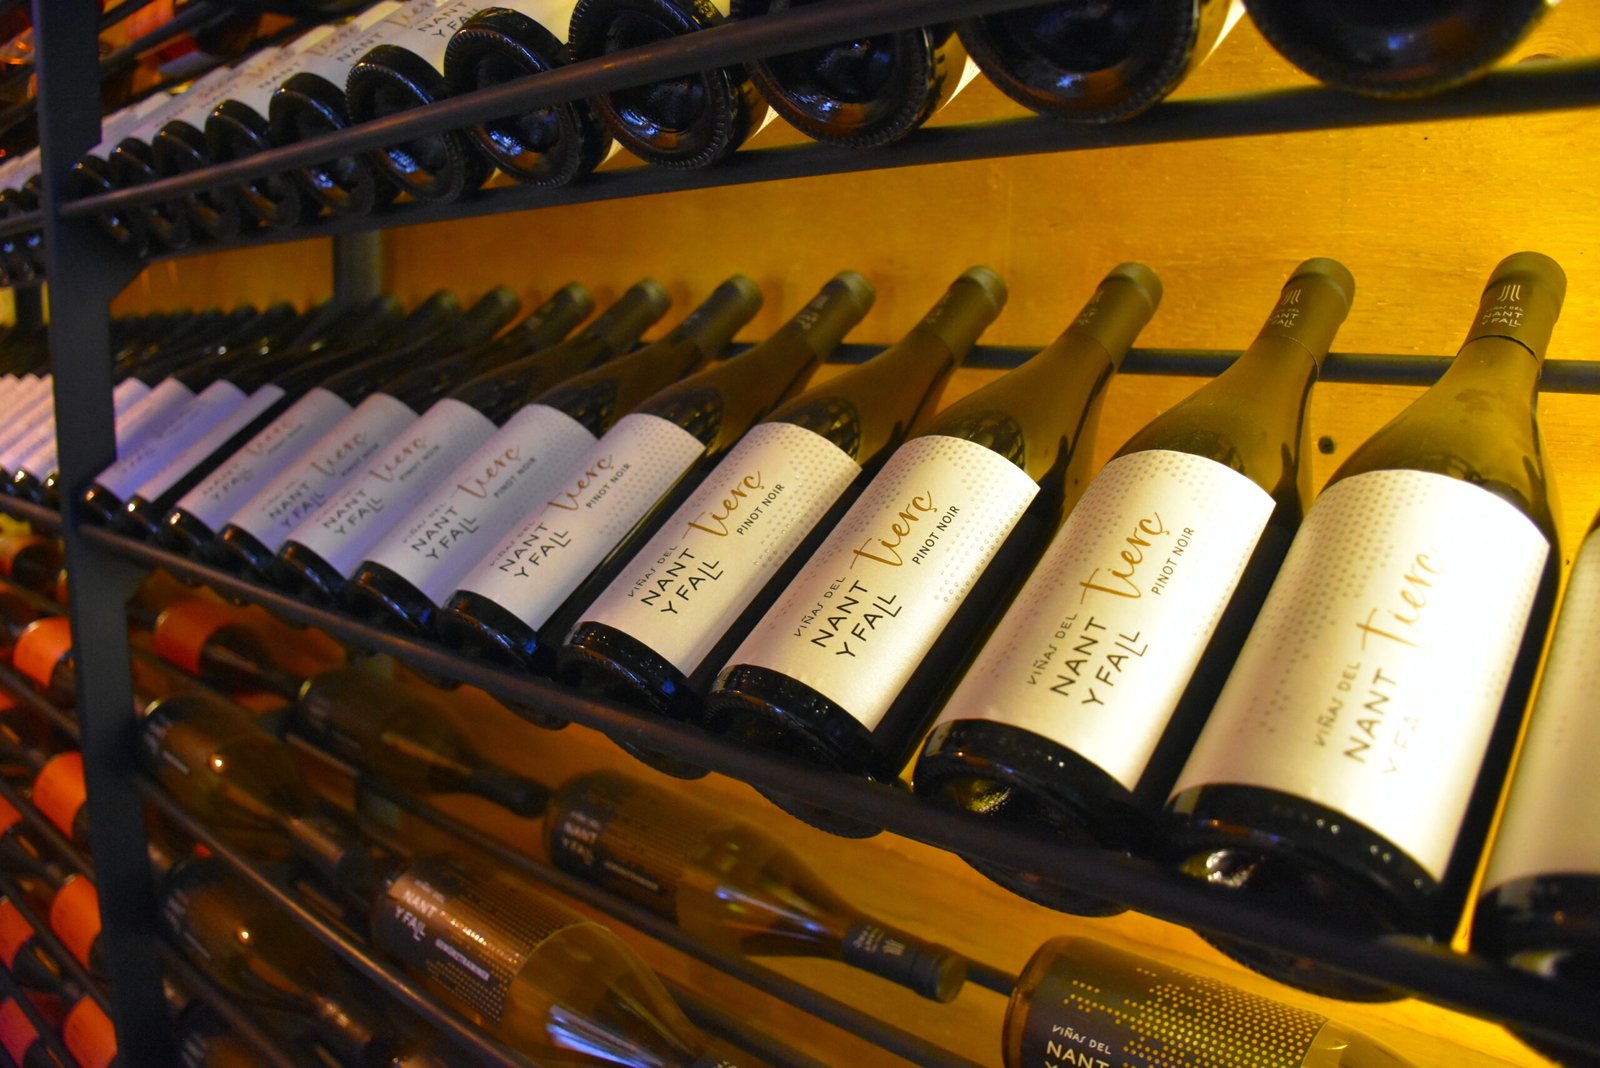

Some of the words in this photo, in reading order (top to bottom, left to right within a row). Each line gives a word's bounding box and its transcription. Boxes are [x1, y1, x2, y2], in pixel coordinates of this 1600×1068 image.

[585, 482, 611, 509] PINOT
[609, 462, 632, 485] NOIR
[736, 503, 764, 537] PINOT
[762, 483, 786, 508] NOIR
[411, 505, 459, 553] NANT
[425, 547, 440, 561] Y
[439, 514, 481, 551] FALL
[499, 522, 549, 573] NANT
[513, 565, 530, 580] Y
[528, 528, 573, 567] FALL
[911, 530, 940, 566] PINOT
[938, 504, 961, 533] NOIR
[627, 567, 657, 598] VIÑAS
[656, 544, 679, 566] DEL
[640, 547, 696, 606] NANT
[660, 600, 679, 617] Y
[676, 559, 725, 602] FALL
[1151, 556, 1179, 596] PINOT
[1172, 526, 1195, 557] NOIR
[793, 601, 824, 638] VIÑAS
[823, 574, 847, 600] DEL
[810, 580, 869, 648] NANT
[835, 641, 857, 659] Y
[850, 593, 903, 643] FALL
[1026, 644, 1058, 686] VIÑAS
[1056, 612, 1079, 640] DEL
[1049, 616, 1107, 697] NANT
[1081, 688, 1105, 706] Y
[1095, 629, 1150, 688] FALL
[1336, 661, 1362, 693] DEL
[1343, 667, 1398, 764] NANT
[1046, 1040, 1111, 1068] NANT
[1051, 1024, 1087, 1044] VIÑAS
[1088, 1038, 1112, 1056] DEL
